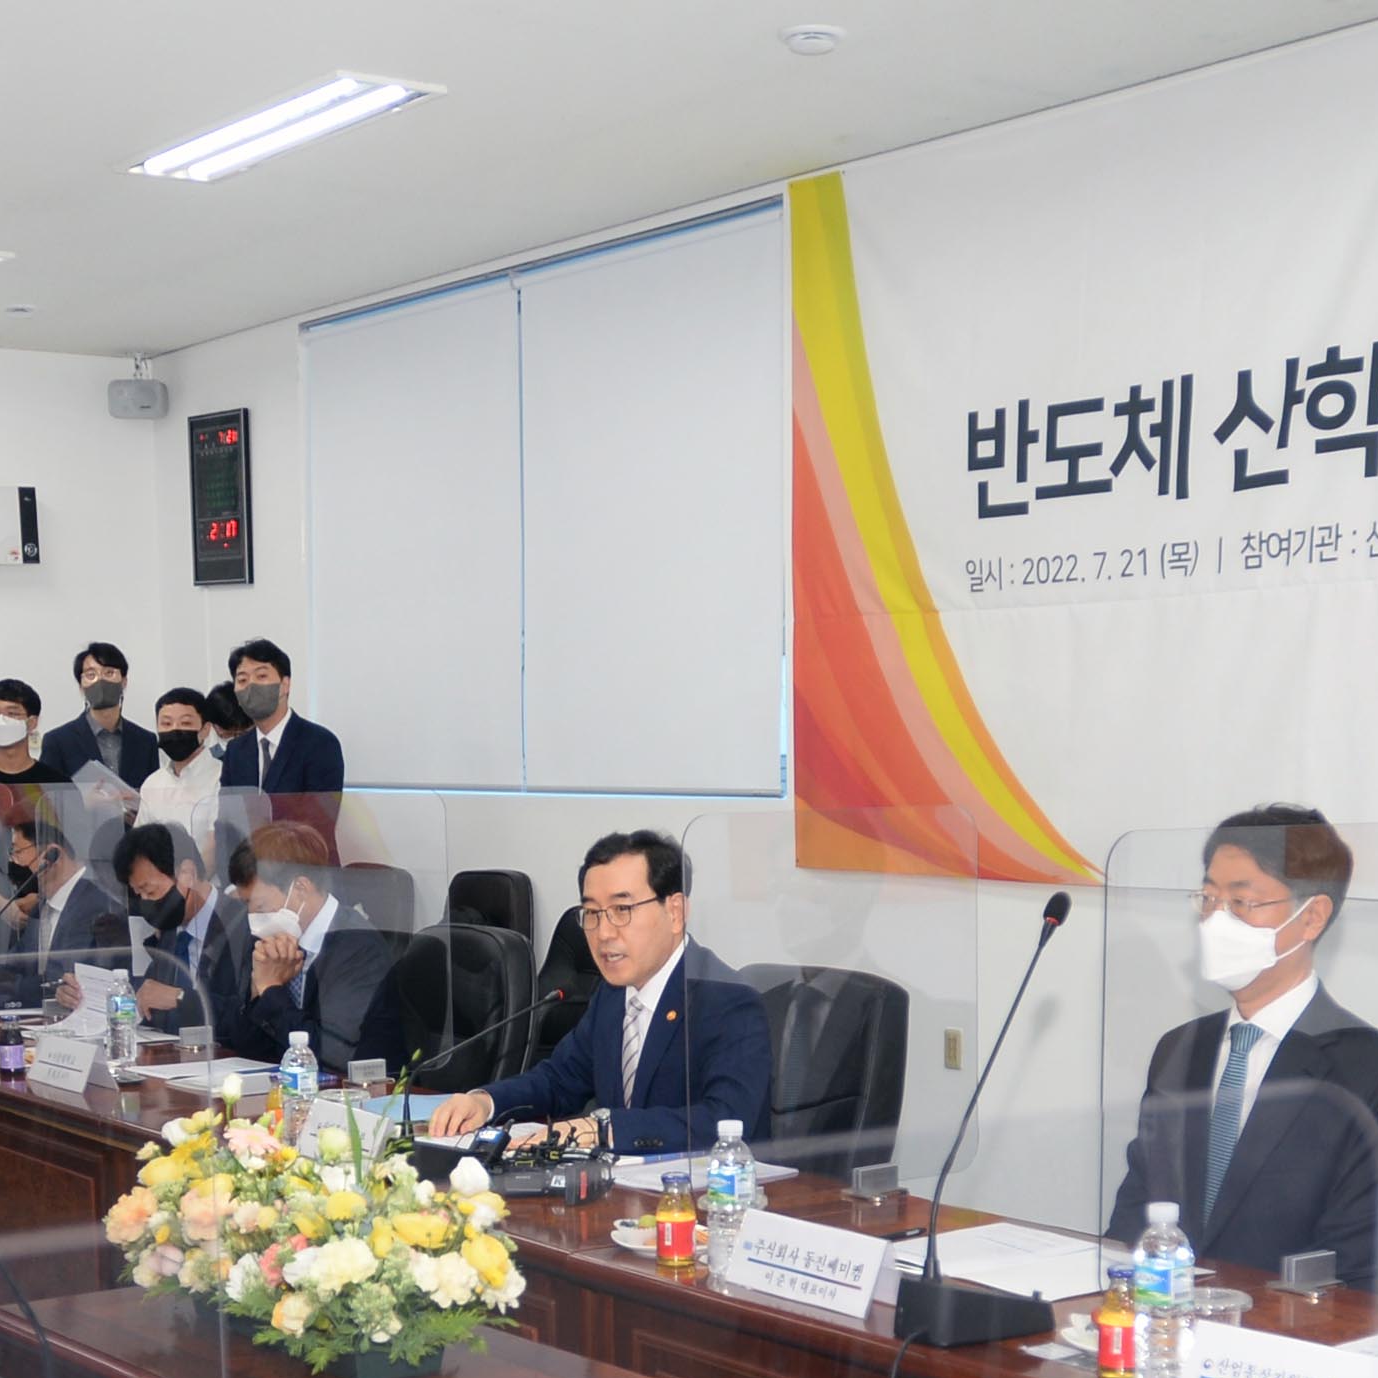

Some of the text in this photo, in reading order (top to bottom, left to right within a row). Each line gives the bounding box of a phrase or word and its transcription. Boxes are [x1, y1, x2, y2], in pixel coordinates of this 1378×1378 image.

[965, 372, 1194, 521] 반도체
[964, 556, 1003, 593] 일시
[1022, 553, 1086, 586] 2022.
[1092, 551, 1112, 581] 7.
[1119, 547, 1148, 579] 21
[1160, 539, 1200, 580] (목)
[1240, 522, 1344, 571] 참여기관
[754, 1238, 800, 1265] 주식회사
